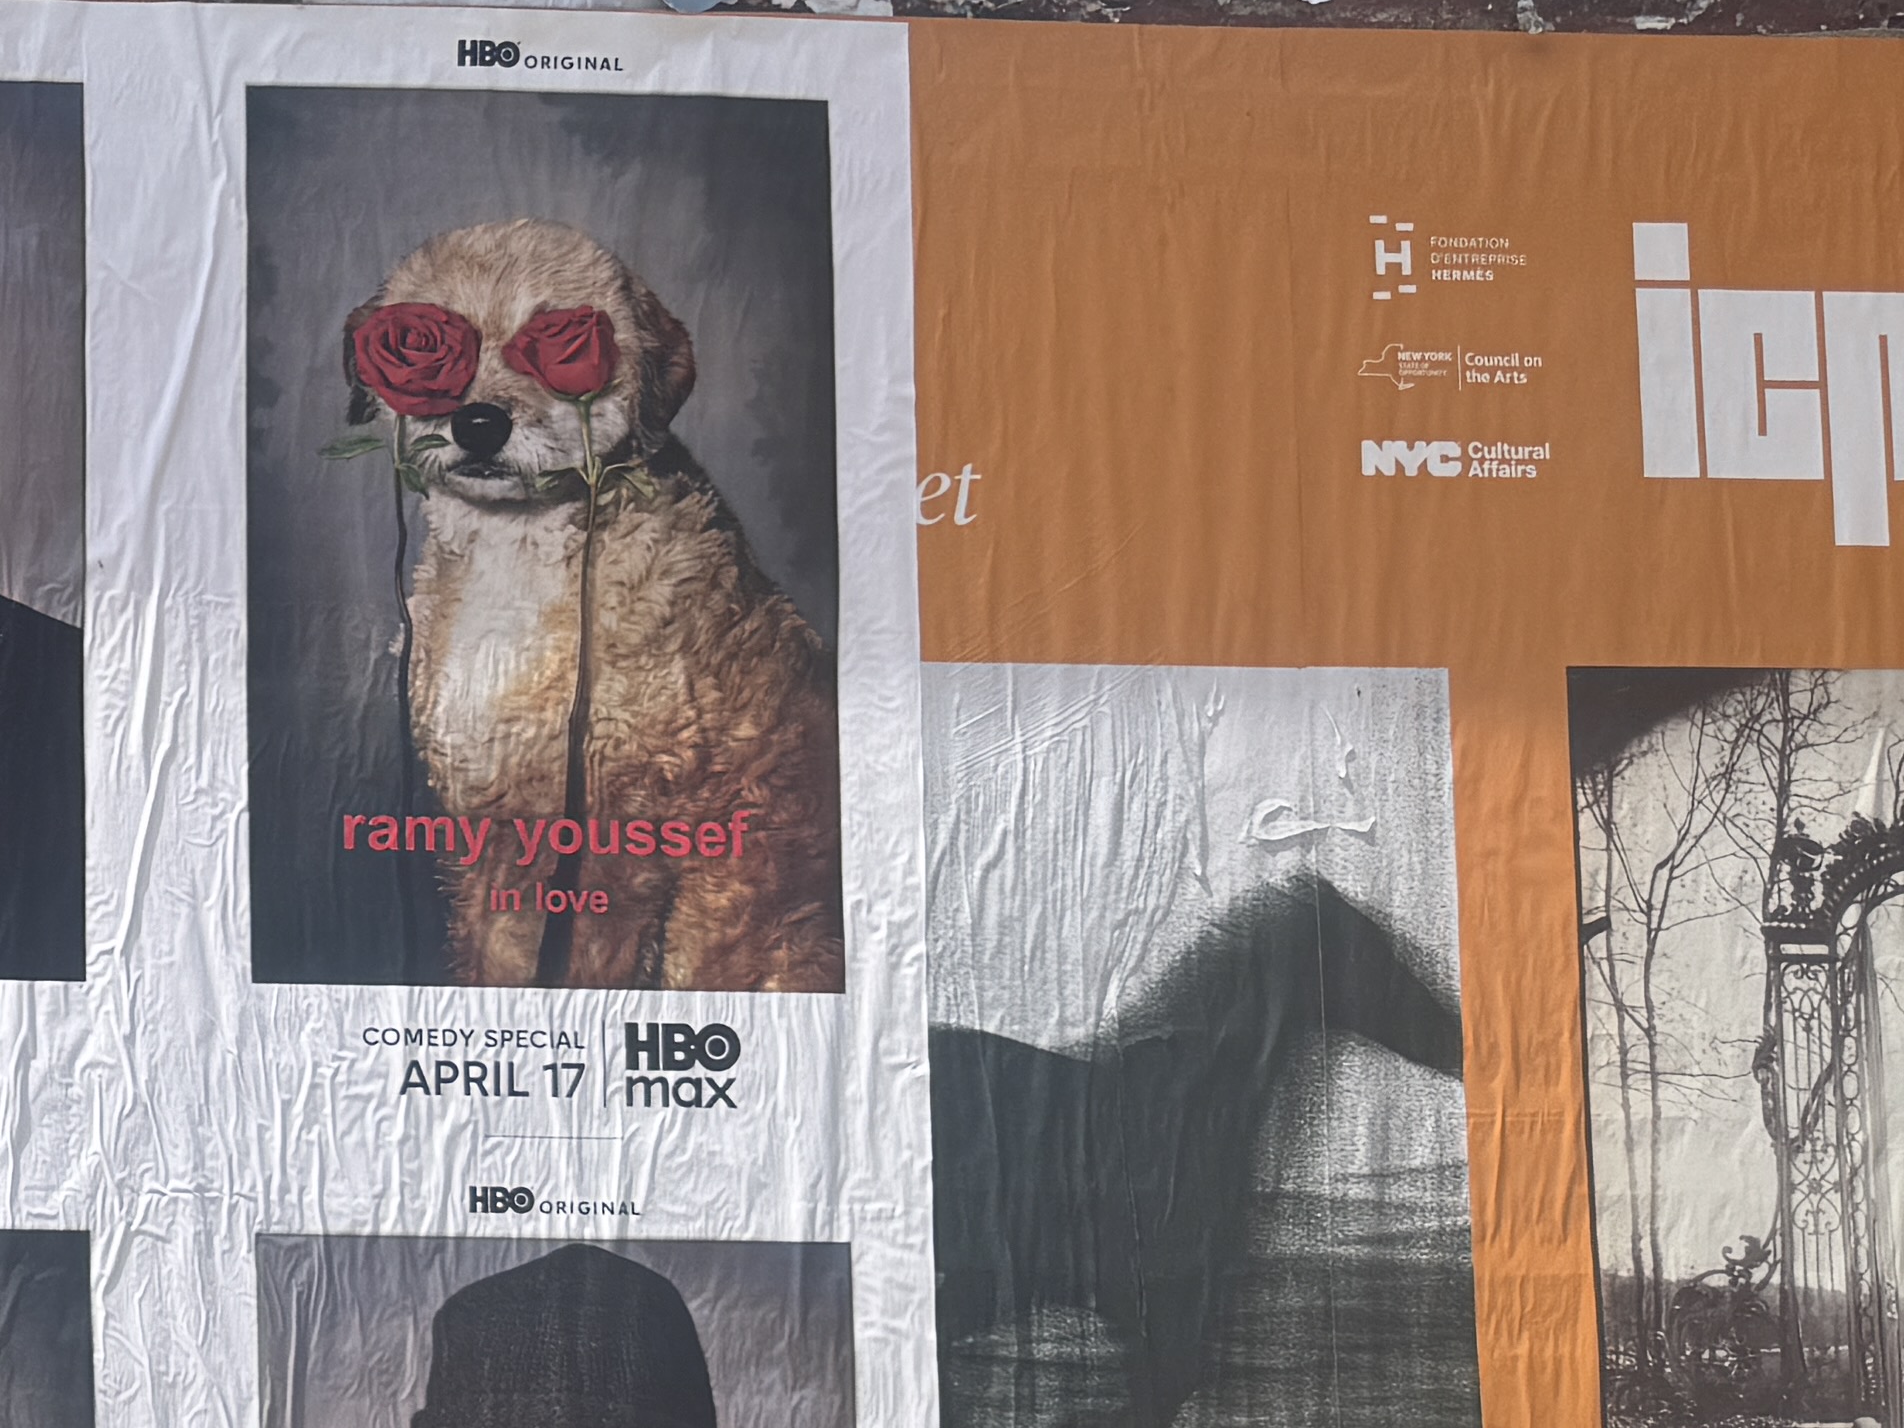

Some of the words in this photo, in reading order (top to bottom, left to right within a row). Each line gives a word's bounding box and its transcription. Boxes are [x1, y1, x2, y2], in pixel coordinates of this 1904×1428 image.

[457, 40, 520, 67] HBO
[524, 56, 624, 71] ORIGINAL
[1430, 236, 1509, 249] FONDATION
[1398, 352, 1422, 360] NEW
[1424, 352, 1452, 361] YORK
[1465, 352, 1519, 367] Council
[1524, 354, 1542, 367] on
[1466, 369, 1490, 383] the
[1494, 371, 1527, 384] Arts
[1361, 440, 1462, 477] NYC
[1468, 441, 1550, 460] Cultural
[1468, 461, 1536, 478] Affairs
[343, 813, 491, 866] ramy
[514, 810, 752, 864] youssef
[490, 883, 521, 910] in
[536, 883, 608, 913] love
[362, 1027, 474, 1047] COMEDY
[484, 1030, 585, 1049] SPECIAL
[624, 1022, 741, 1072] HBO
[399, 1060, 529, 1097] APRIL
[543, 1062, 585, 1098] 17
[625, 1076, 737, 1108] max
[469, 1186, 535, 1214] HBO
[538, 1200, 640, 1216] ORIGINAL
